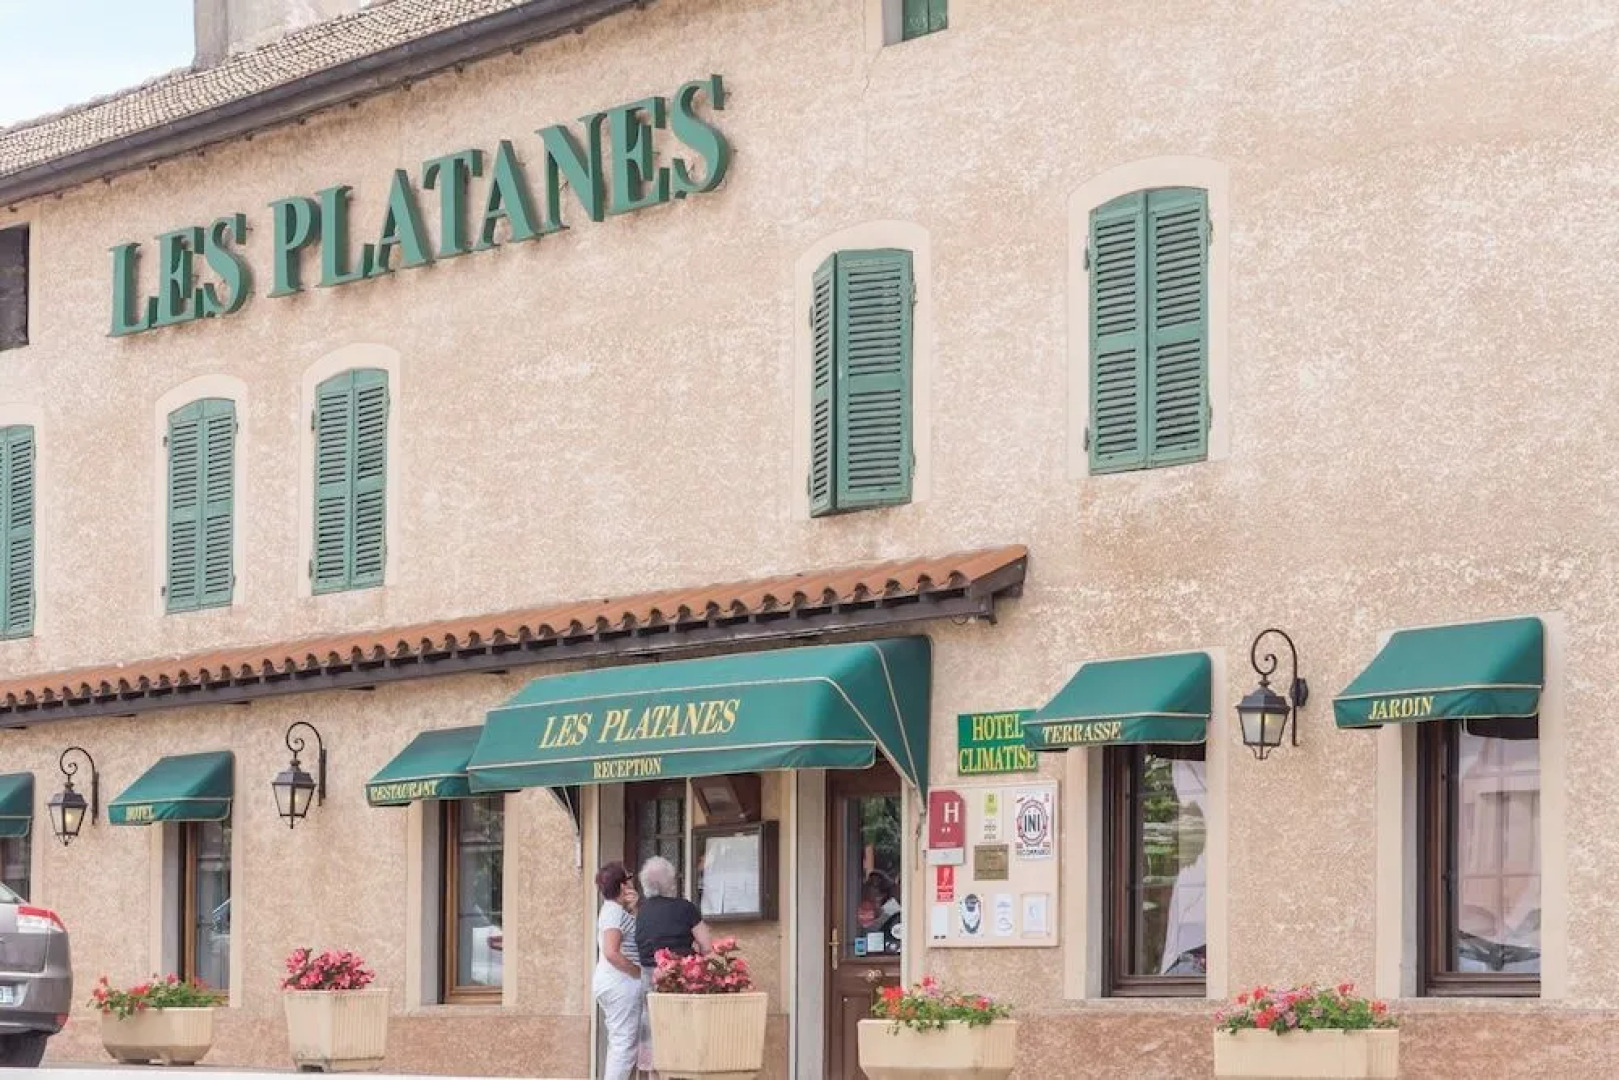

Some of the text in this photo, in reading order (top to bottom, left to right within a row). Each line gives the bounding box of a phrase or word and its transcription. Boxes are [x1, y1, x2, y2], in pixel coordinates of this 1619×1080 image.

[106, 74, 730, 337] LES PLATANES
[1367, 695, 1435, 720] JARDIN
[538, 699, 740, 748] LES PLATANES
[972, 713, 1024, 741] HOTEL
[1042, 721, 1122, 744] TERRASSE
[593, 756, 662, 779] RECEPTION
[943, 802, 960, 823] H
